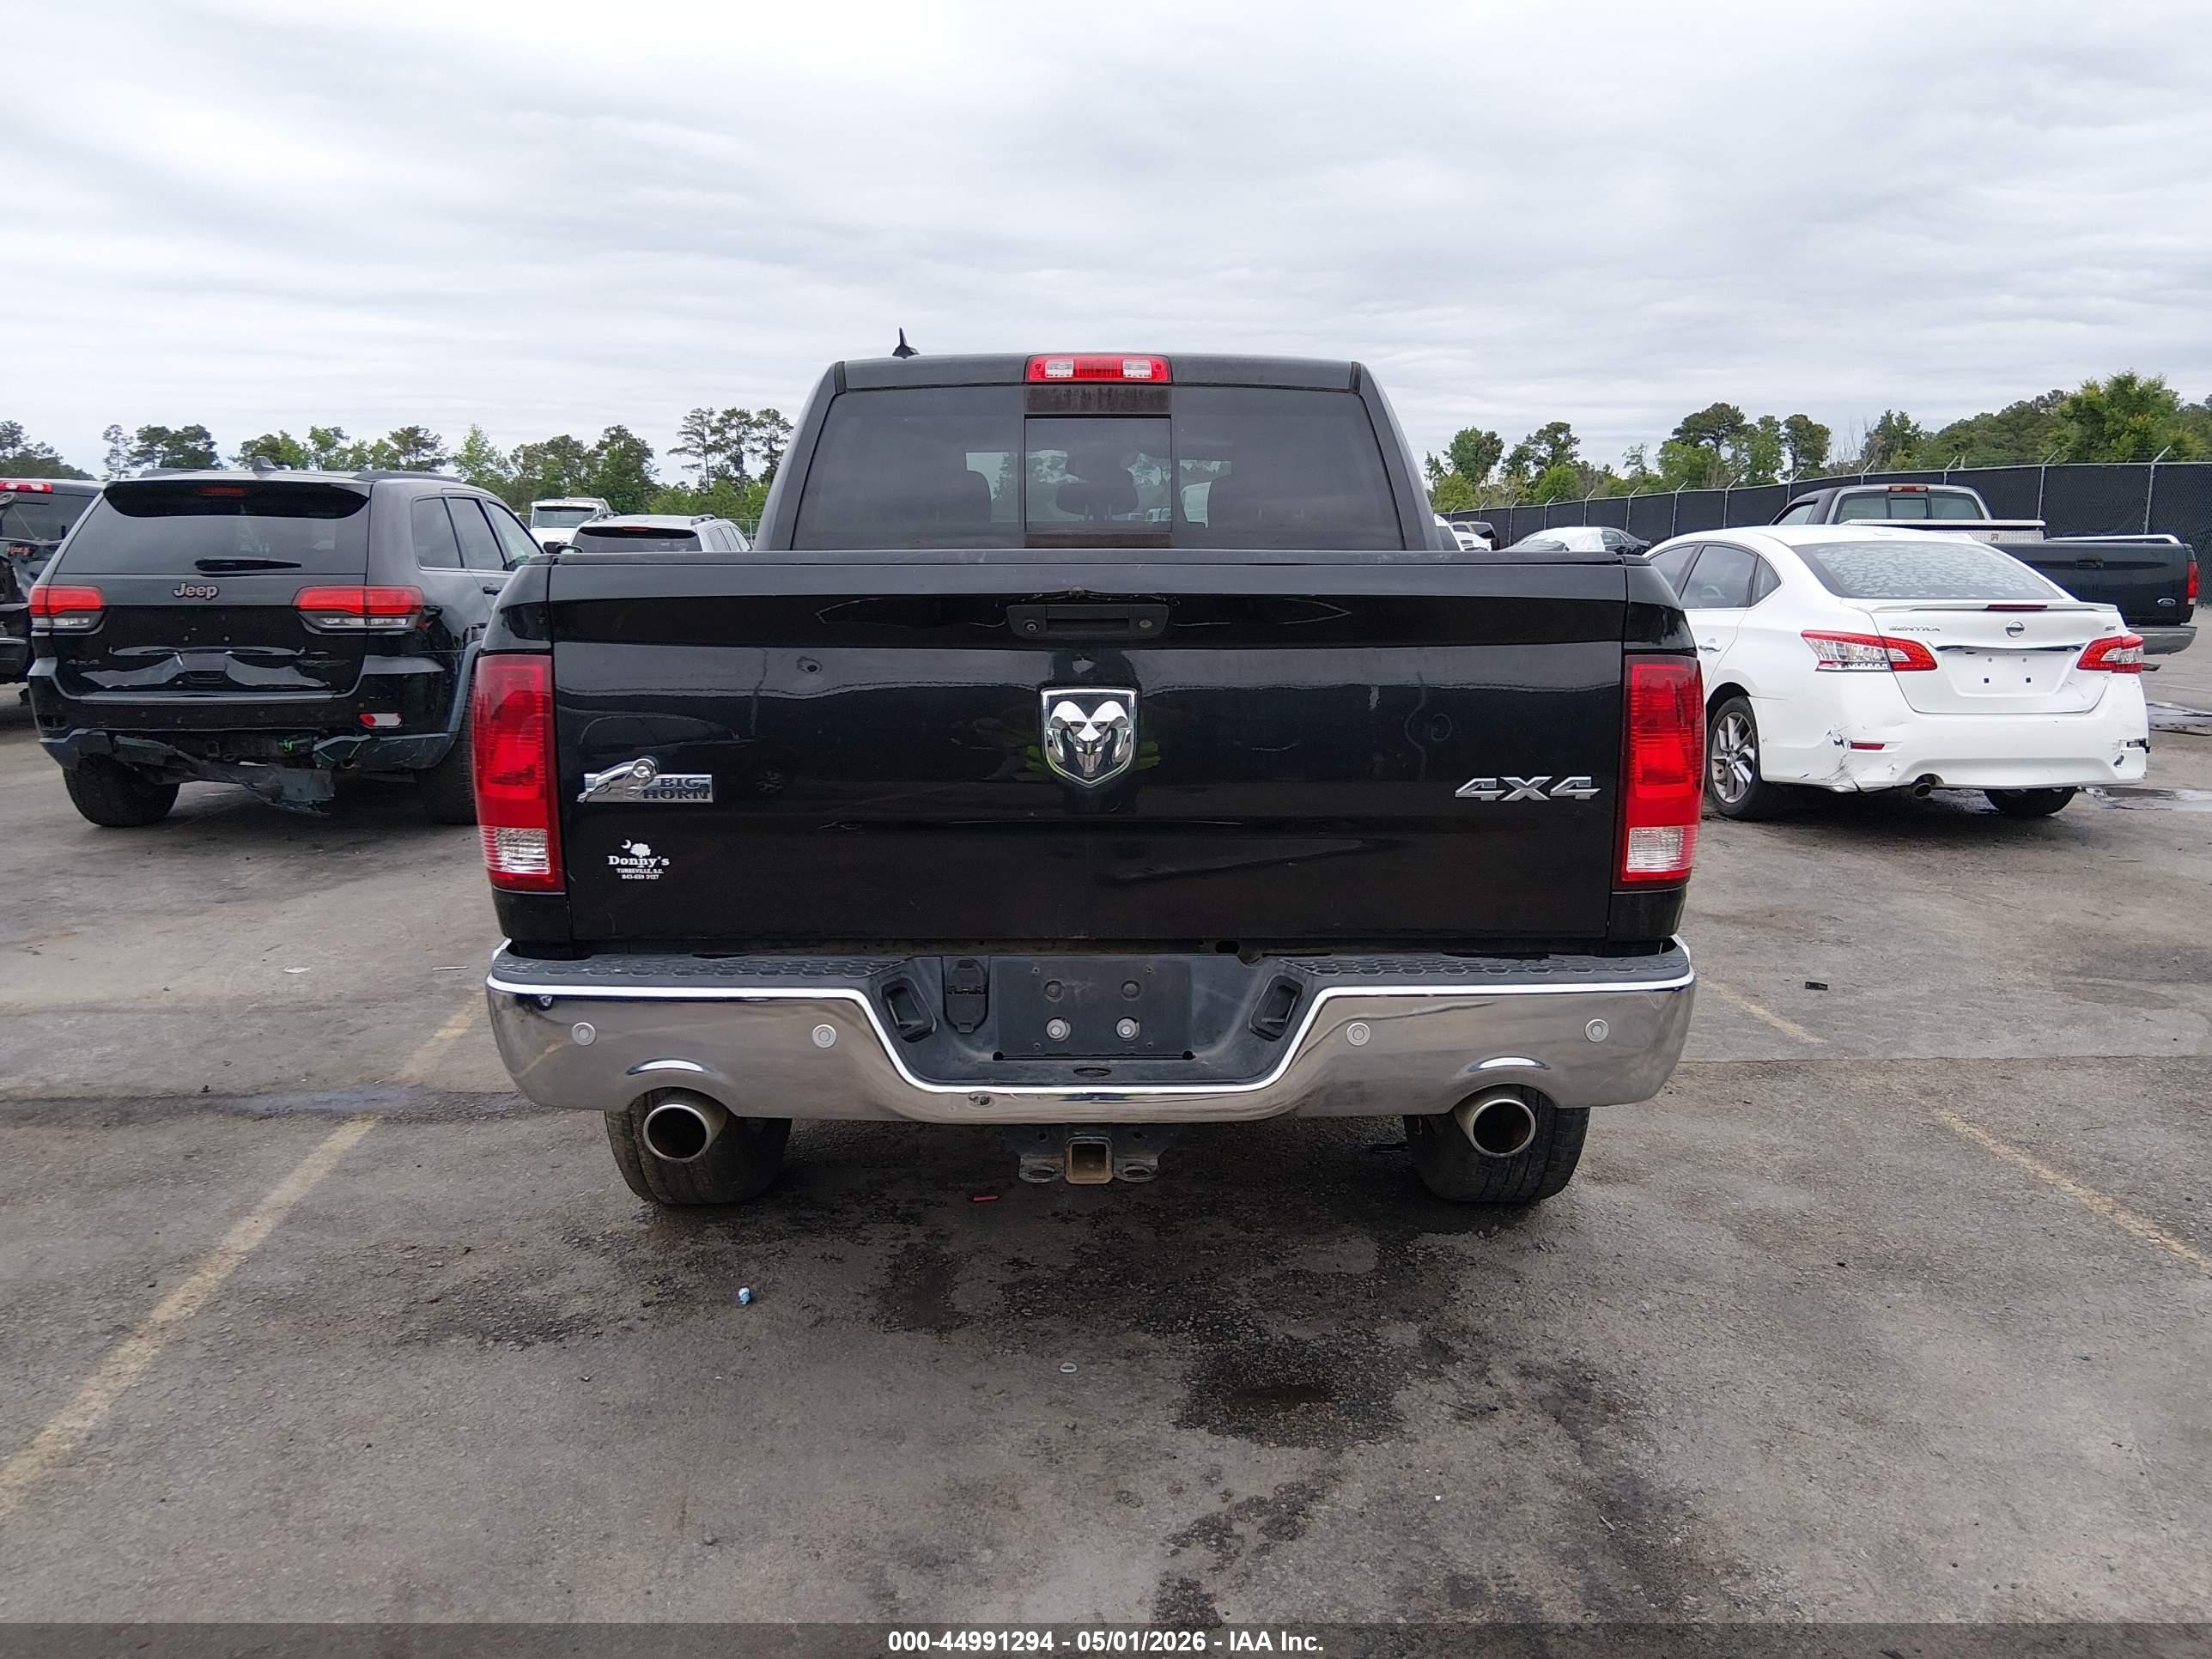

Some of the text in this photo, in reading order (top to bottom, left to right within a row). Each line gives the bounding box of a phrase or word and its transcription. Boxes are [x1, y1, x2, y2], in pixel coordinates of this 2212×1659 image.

[173, 582, 219, 600] Jeep
[659, 777, 710, 788] BIG
[643, 789, 709, 799] HORN
[607, 855, 670, 867] Donny's
